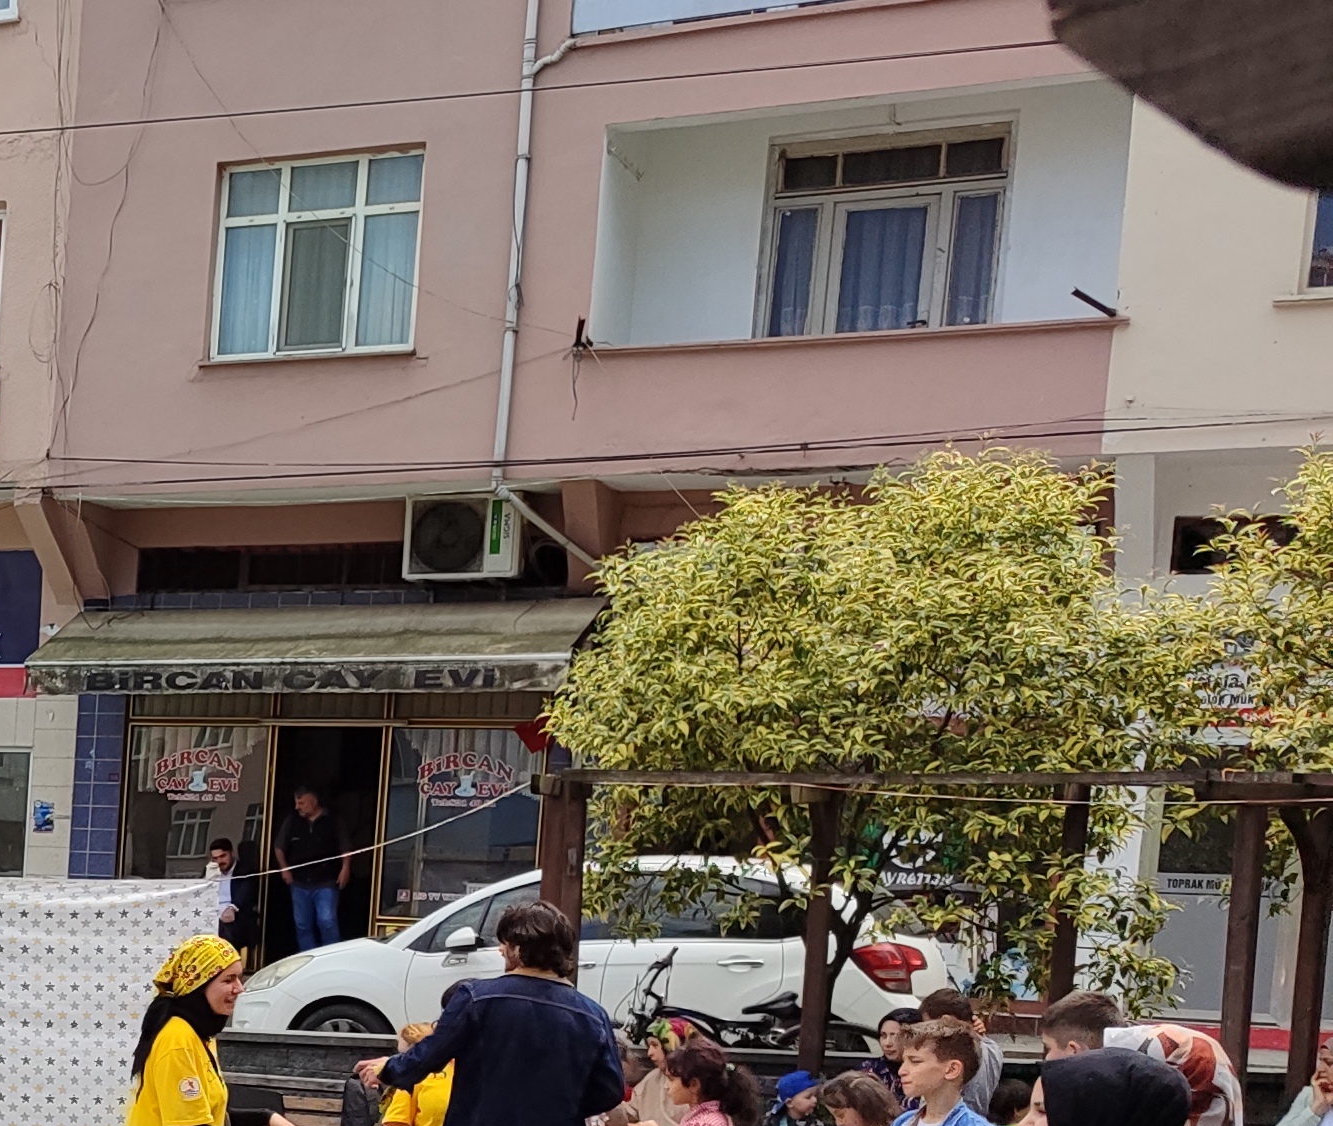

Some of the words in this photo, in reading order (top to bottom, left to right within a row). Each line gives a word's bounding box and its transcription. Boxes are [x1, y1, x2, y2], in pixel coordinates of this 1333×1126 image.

[155, 776, 190, 794] ÇAY
[419, 781, 457, 800] ÇAY
[1167, 878, 1204, 890] TOPRAK
